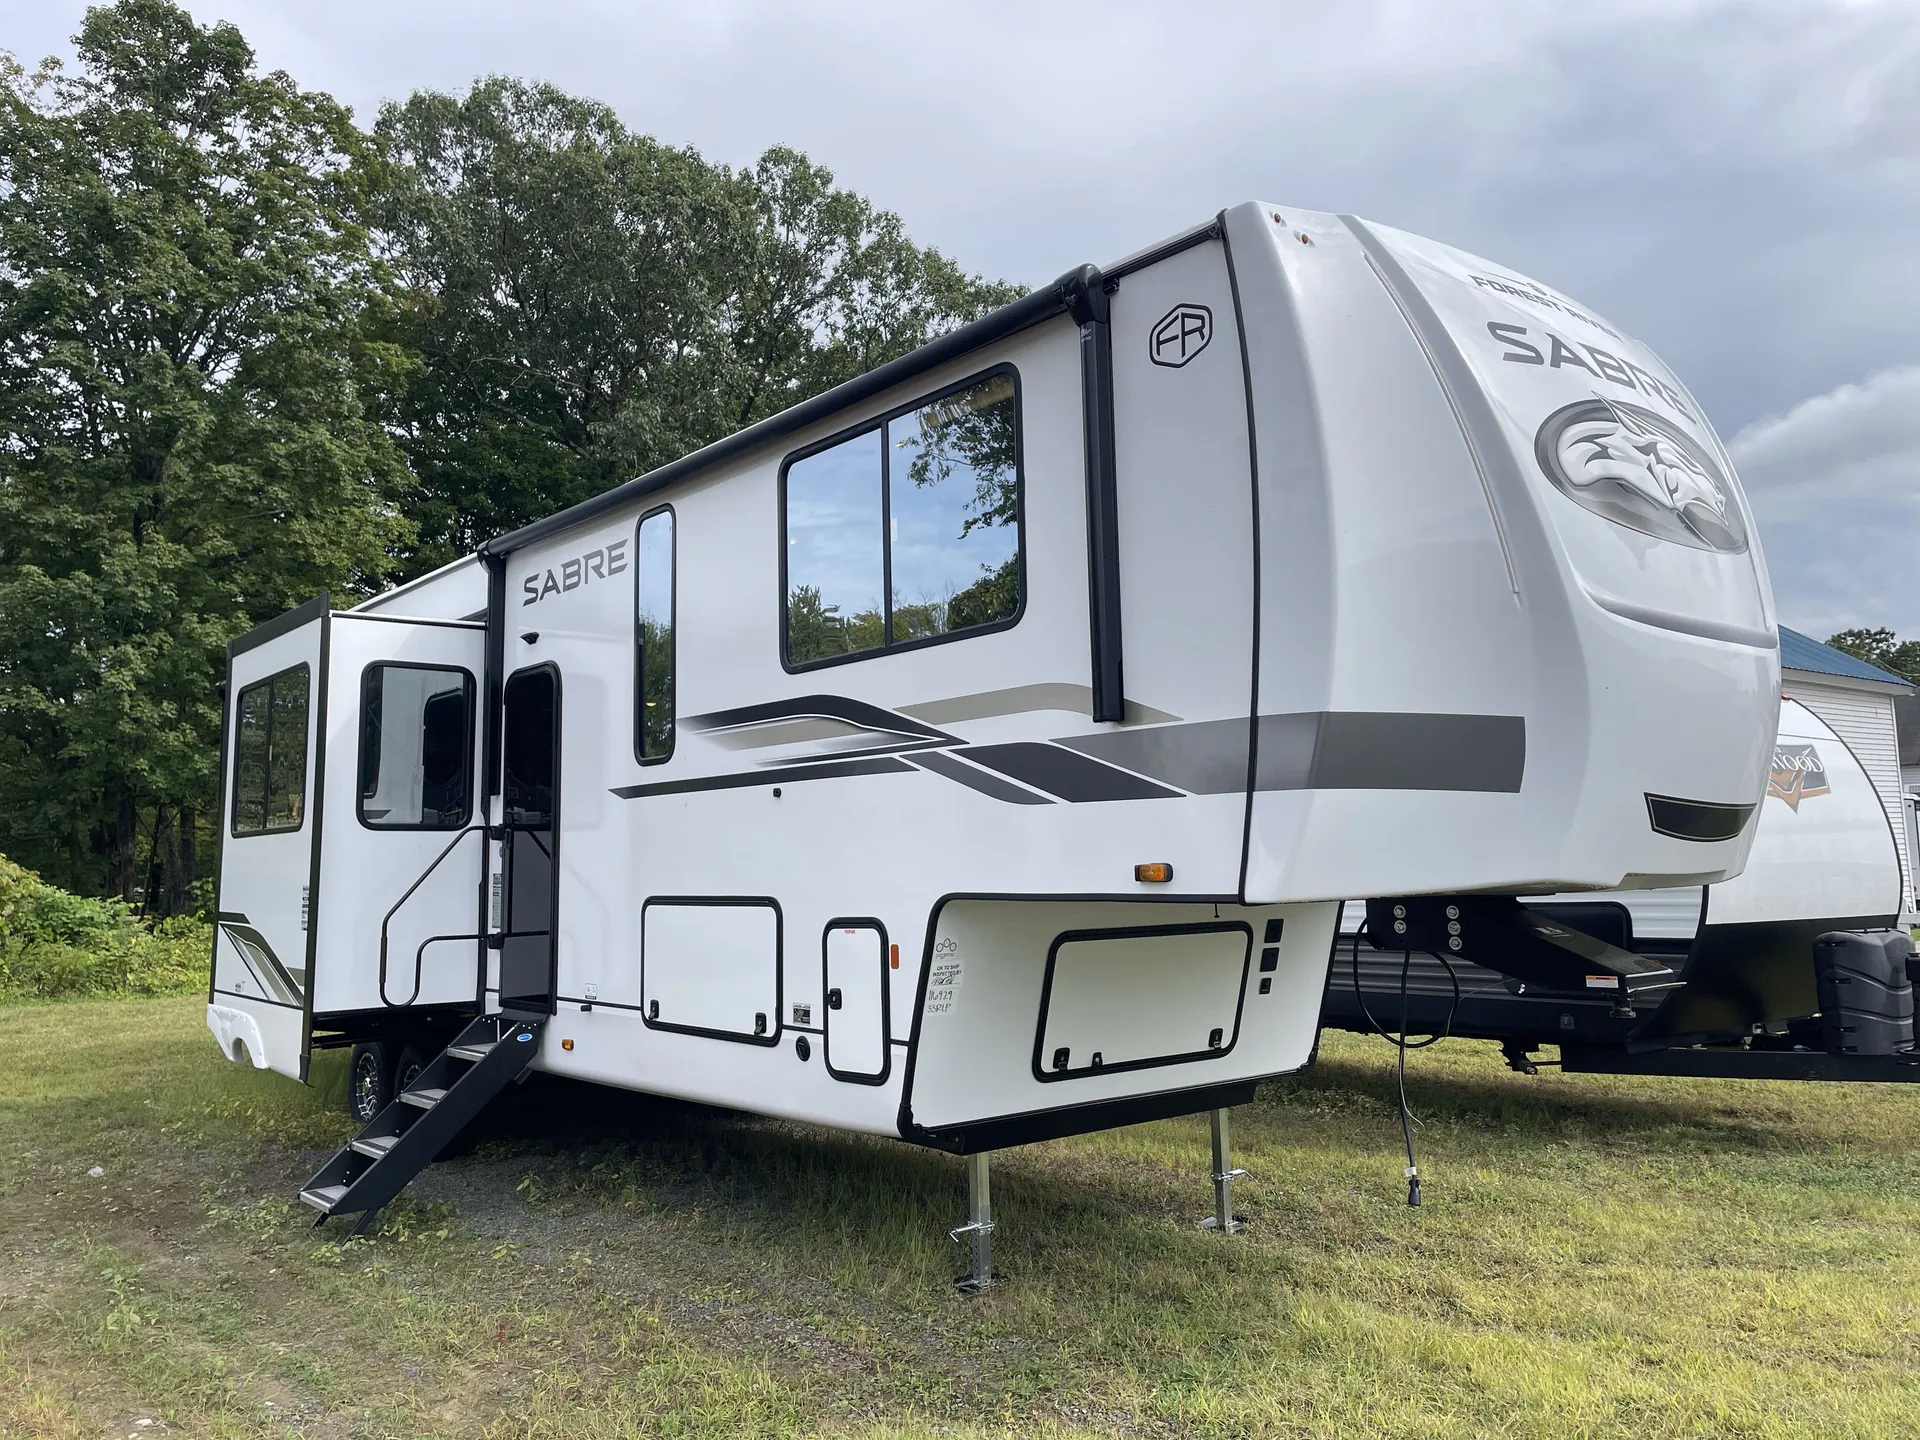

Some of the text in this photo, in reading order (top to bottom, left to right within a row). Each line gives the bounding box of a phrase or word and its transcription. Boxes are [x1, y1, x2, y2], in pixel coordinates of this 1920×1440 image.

[1468, 274, 1563, 312] FOREST
[1487, 320, 1698, 425] SABRE
[523, 538, 628, 607] SABRE
